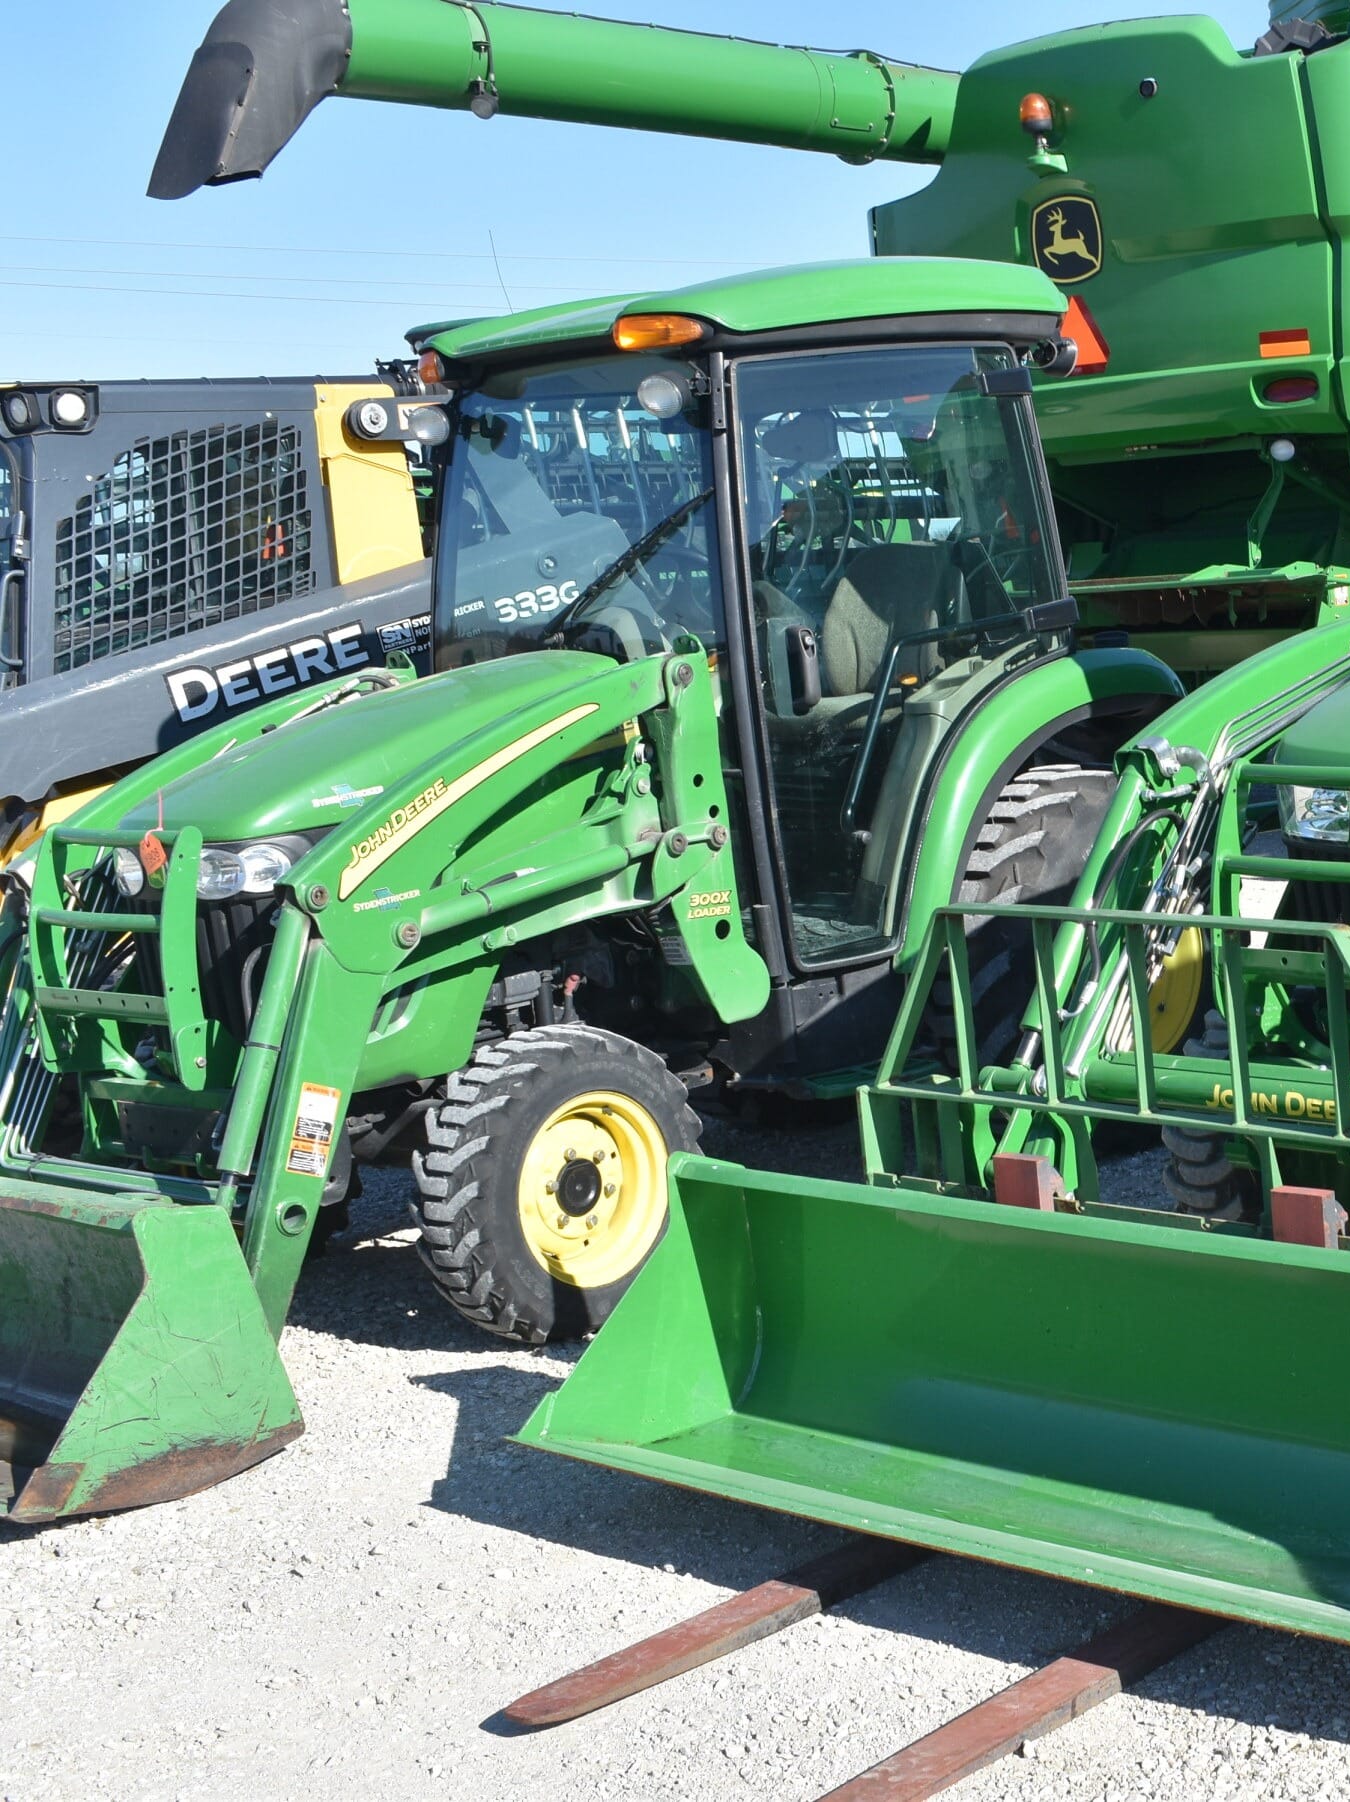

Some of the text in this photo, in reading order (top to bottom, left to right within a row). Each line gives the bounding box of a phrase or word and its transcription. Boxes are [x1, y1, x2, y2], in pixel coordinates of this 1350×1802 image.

[494, 580, 580, 623] 333G
[381, 621, 413, 644] SN
[167, 623, 370, 722] DEERE
[350, 777, 448, 869] JOHN DEERE
[687, 905, 731, 919] LOADER
[689, 890, 732, 907] 300X
